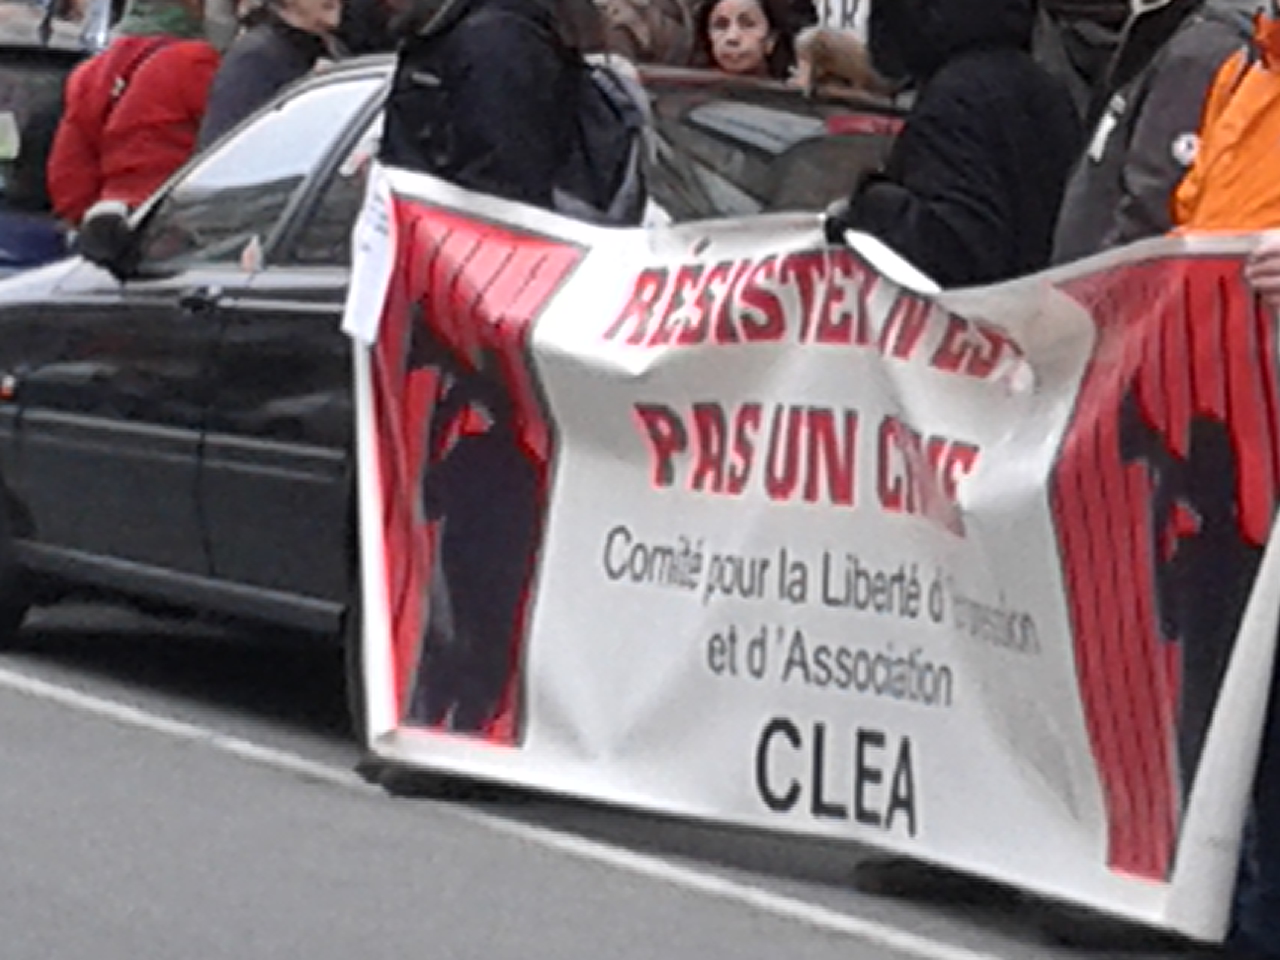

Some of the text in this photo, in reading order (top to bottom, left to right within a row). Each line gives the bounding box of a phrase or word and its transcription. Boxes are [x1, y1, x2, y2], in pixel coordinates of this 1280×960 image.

[633, 402, 763, 496] PAS
[764, 403, 859, 507] UN
[603, 525, 703, 590] Comité
[703, 543, 770, 606] pour
[778, 547, 808, 605] la
[822, 550, 920, 620] Liberté
[707, 624, 738, 676] et
[755, 716, 917, 838] CLEA
